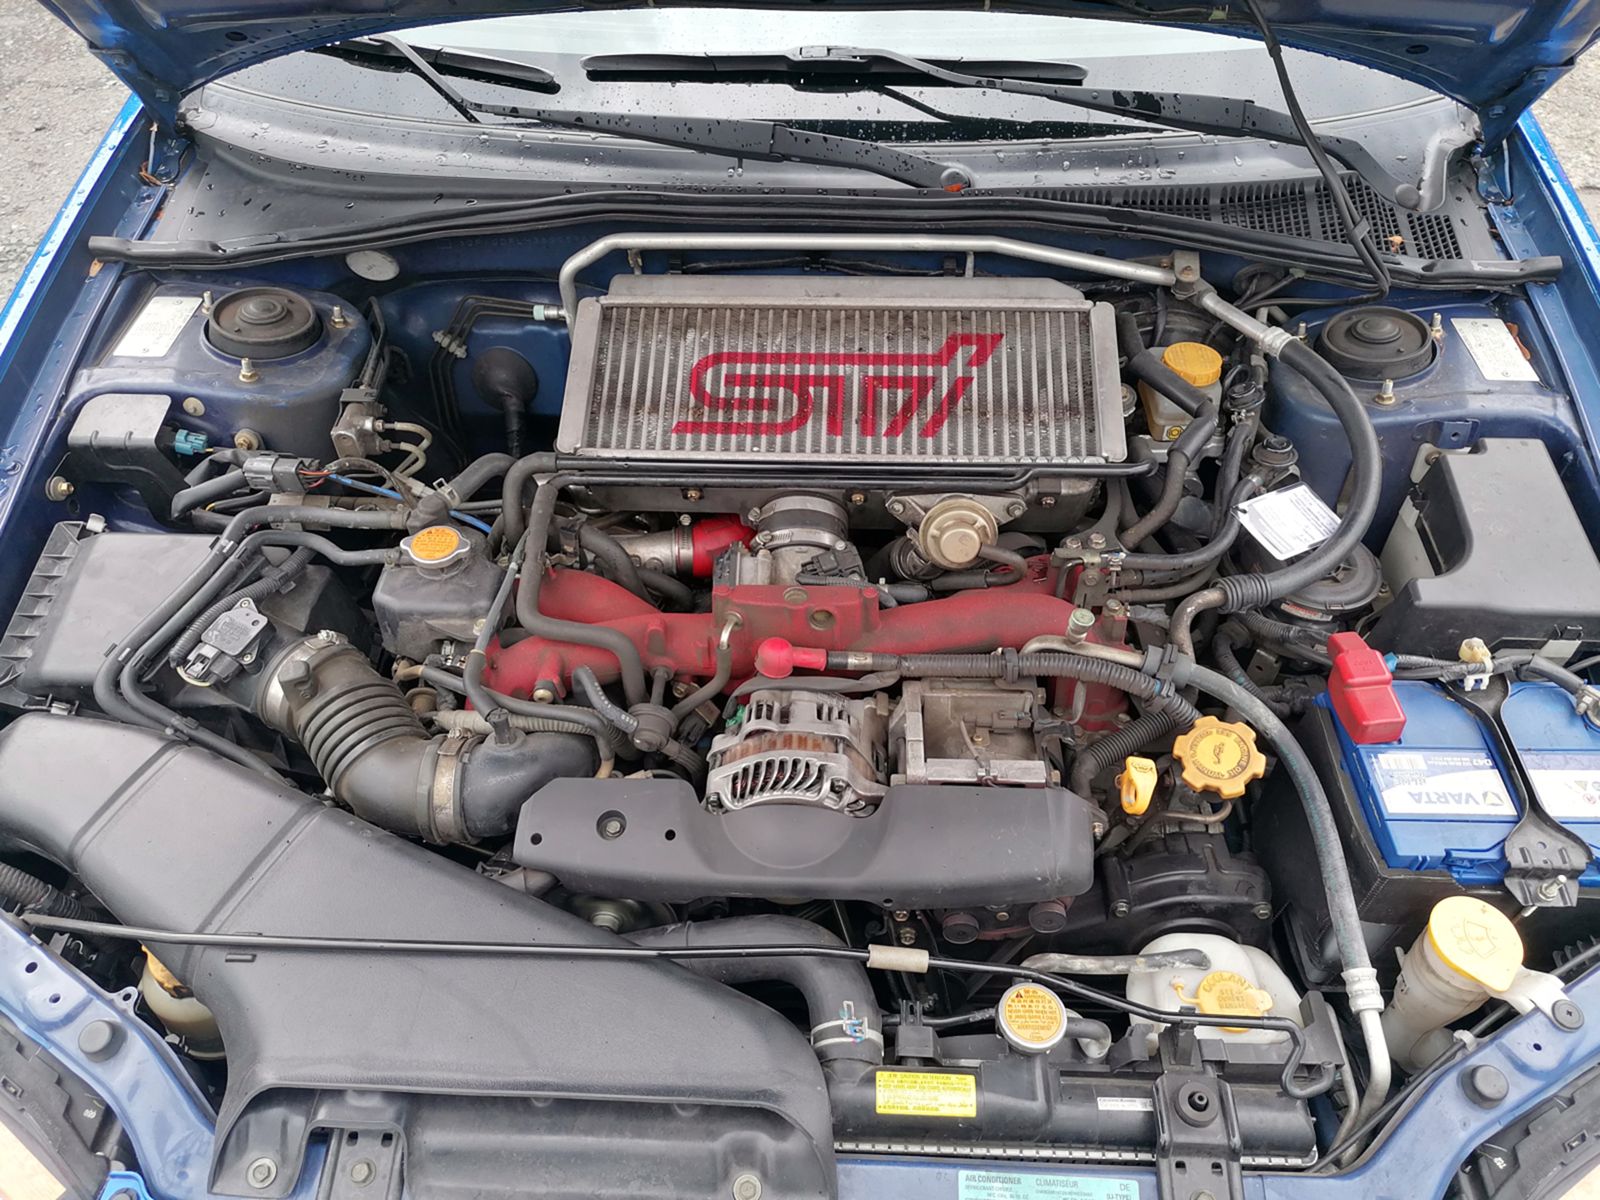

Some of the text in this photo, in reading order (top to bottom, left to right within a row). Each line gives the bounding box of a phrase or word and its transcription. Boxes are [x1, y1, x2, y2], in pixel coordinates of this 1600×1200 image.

[1408, 791, 1480, 806] VARTA
[1202, 973, 1253, 992] COOLANT
[965, 1174, 1022, 1185] AIR CONDITIONER
[1035, 1178, 1079, 1188] CLIMATISEUR
